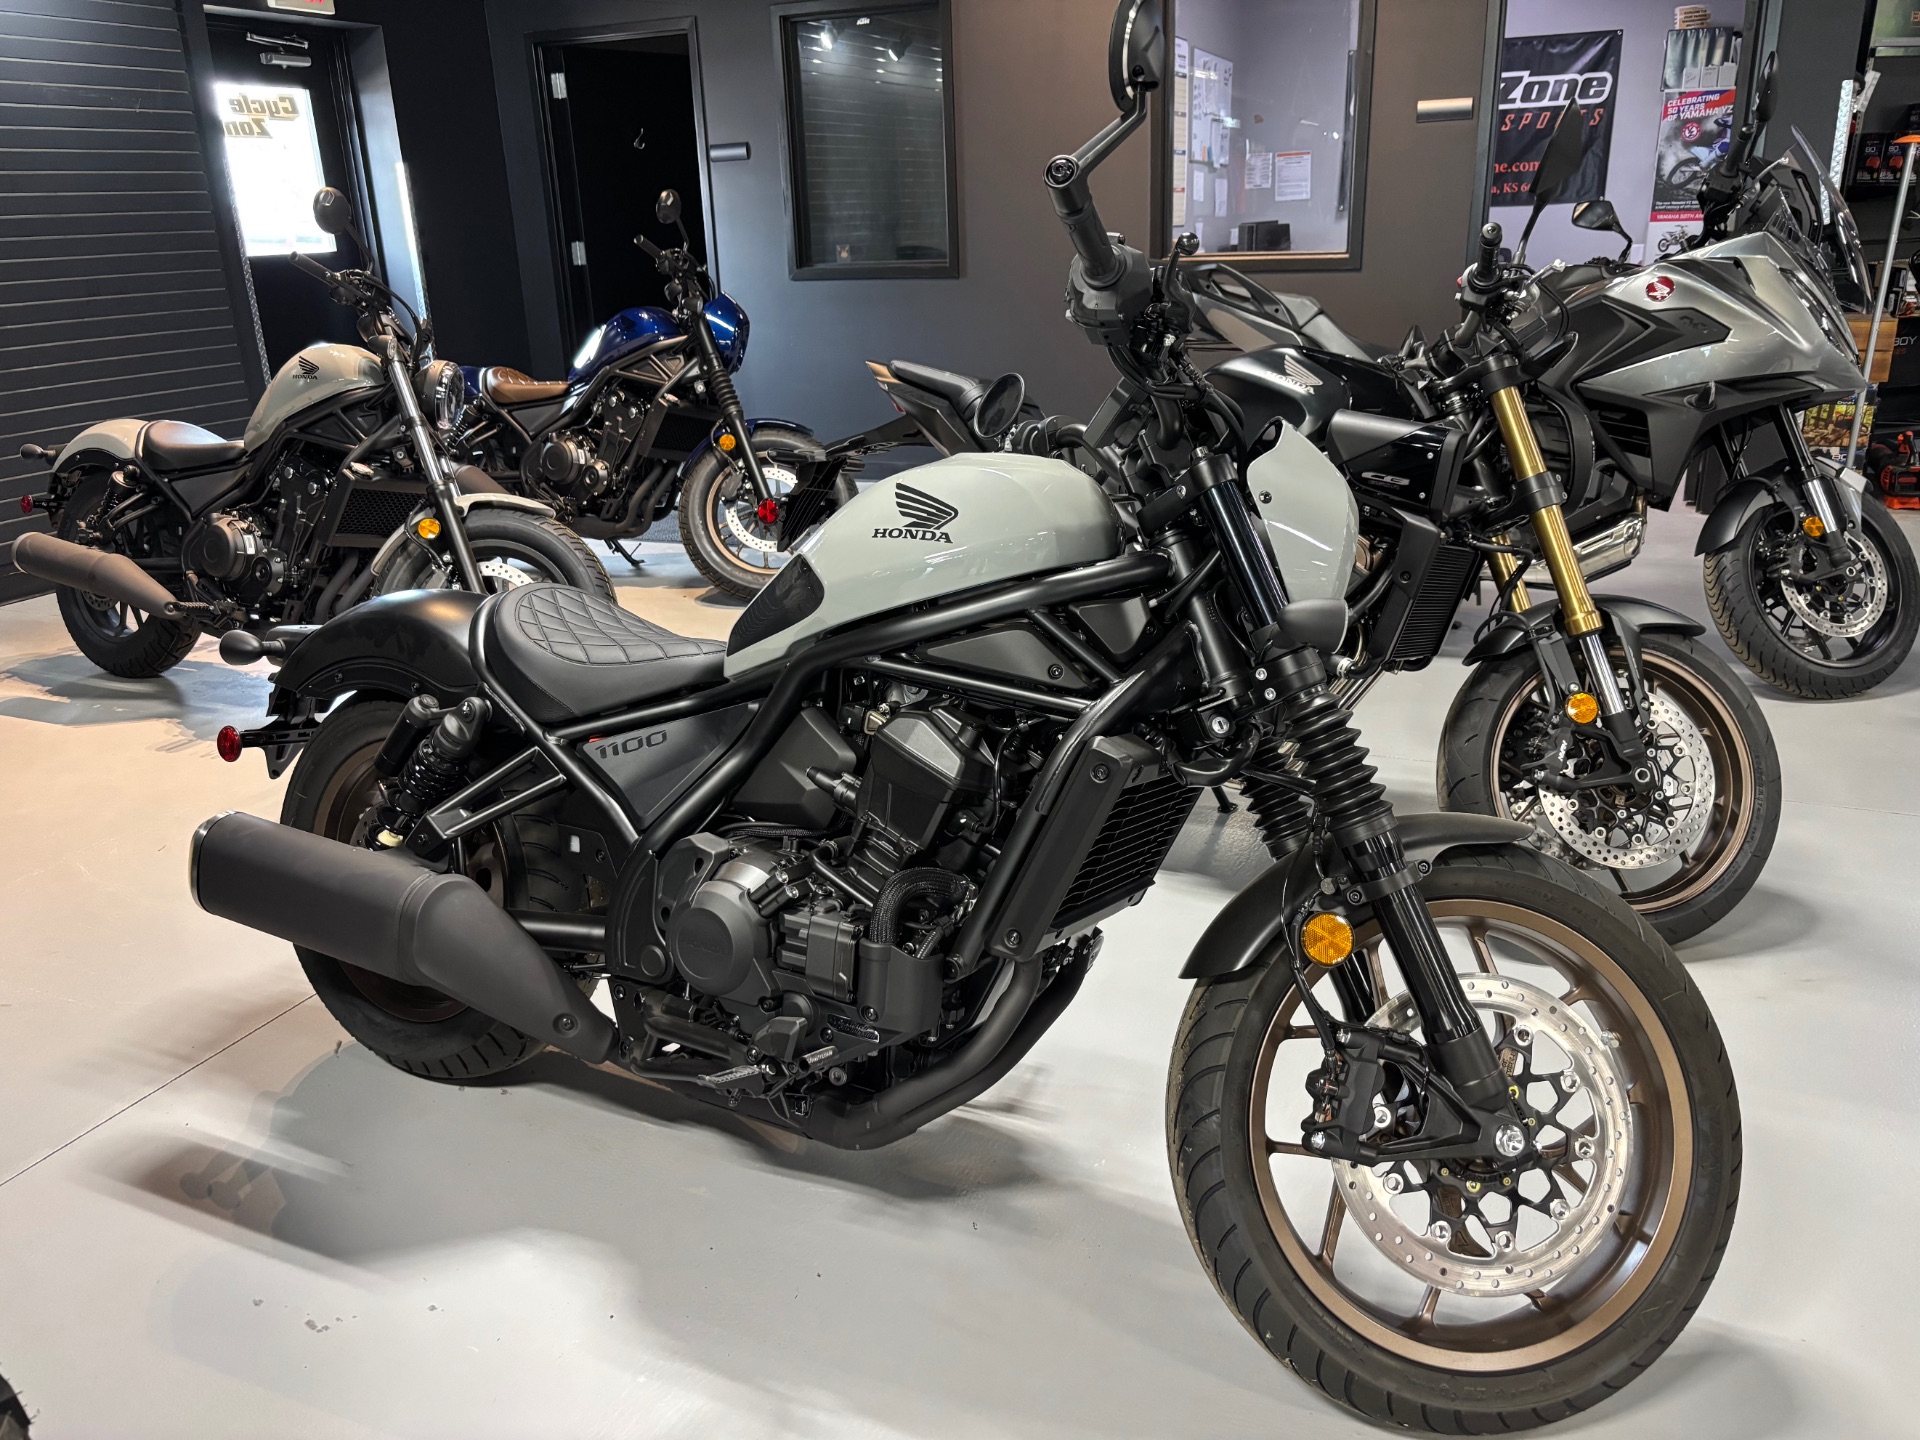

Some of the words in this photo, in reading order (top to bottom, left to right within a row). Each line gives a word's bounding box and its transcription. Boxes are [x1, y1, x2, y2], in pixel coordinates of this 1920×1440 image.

[1500, 72, 1613, 109] Zone
[1667, 93, 1720, 107] CELEBRATING
[1667, 106, 1678, 114] 50
[1679, 102, 1705, 113] YEARS
[1501, 108, 1604, 131] SPOS
[1667, 114, 1678, 122] OF
[1679, 108, 1720, 120] YAMAHA
[1720, 105, 1734, 114] YZ
[1503, 182, 1519, 193] KS
[871, 527, 954, 544] HONDA
[594, 729, 669, 760] 1100
